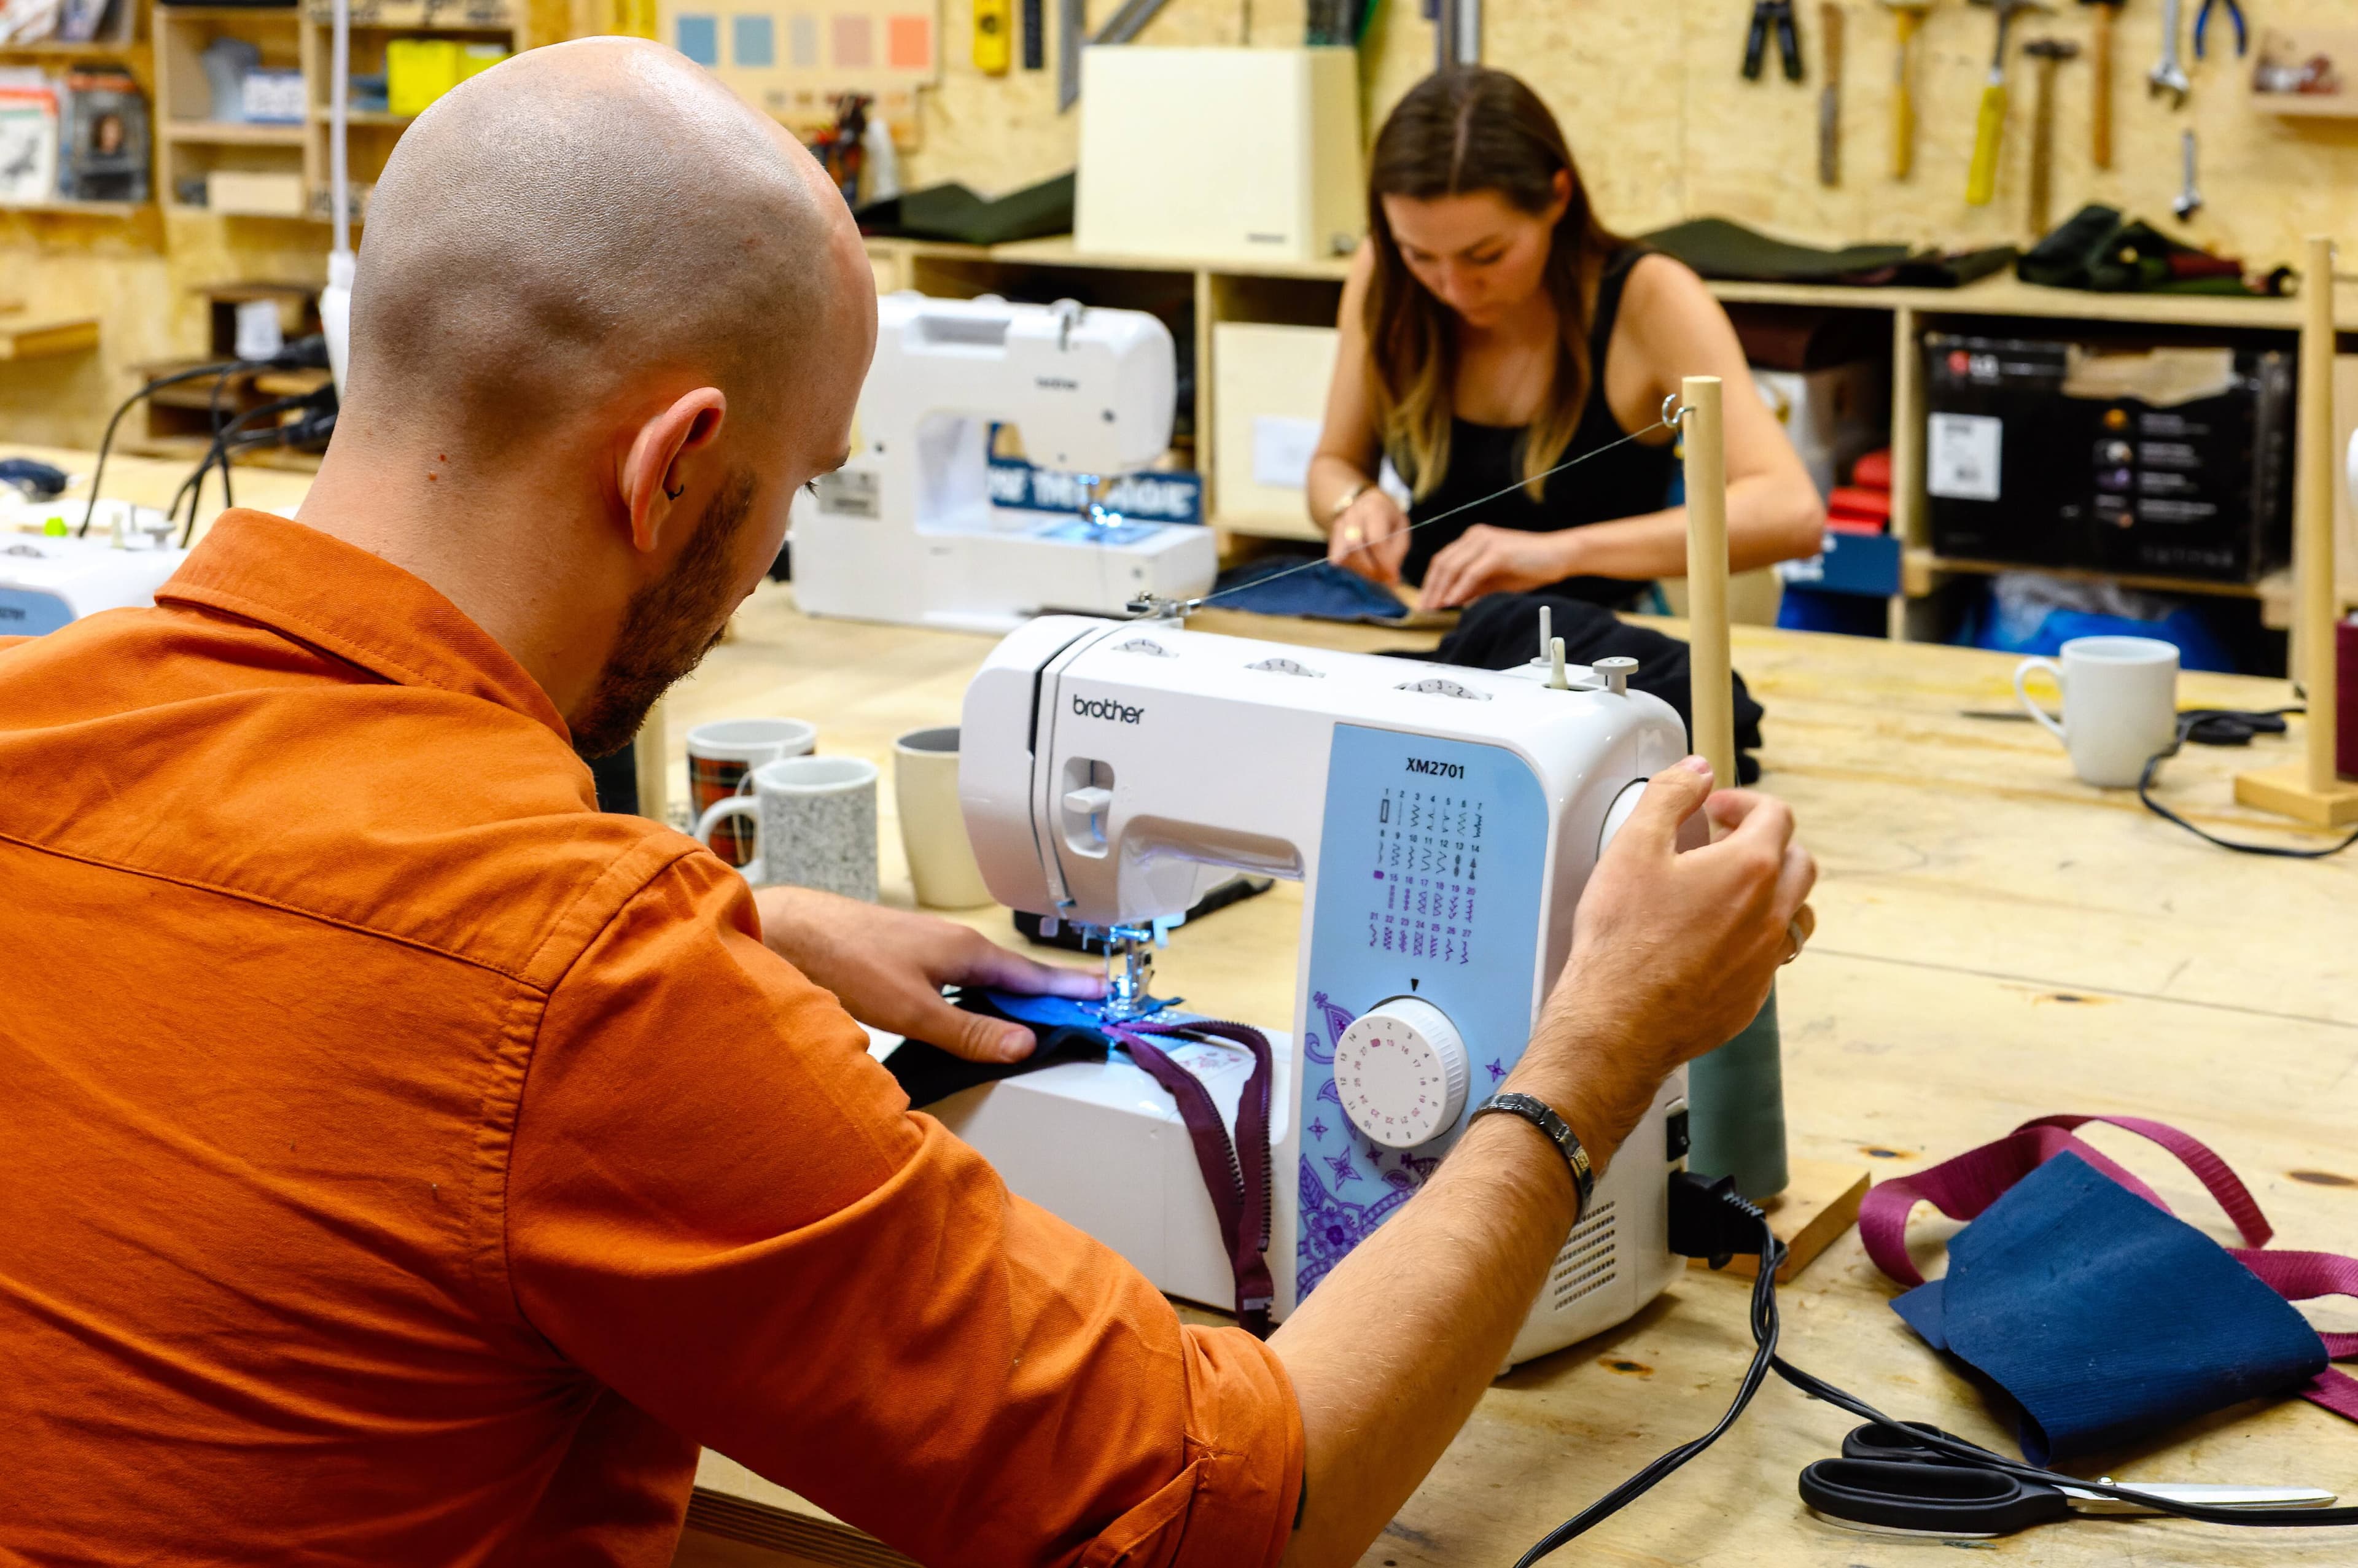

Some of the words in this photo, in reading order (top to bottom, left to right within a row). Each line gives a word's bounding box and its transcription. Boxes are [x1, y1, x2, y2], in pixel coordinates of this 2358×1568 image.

[1437, 680, 1442, 689] 3
[1457, 687, 1463, 696] 2
[1073, 694, 1144, 724] brother
[1406, 757, 1465, 779] XM2701
[1409, 834, 1418, 843] 10
[1440, 839, 1449, 848] 12
[1456, 842, 1464, 851] 13
[1340, 1052, 1347, 1062] 13
[1401, 1046, 1410, 1055] 16
[1413, 1058, 1422, 1068] 17
